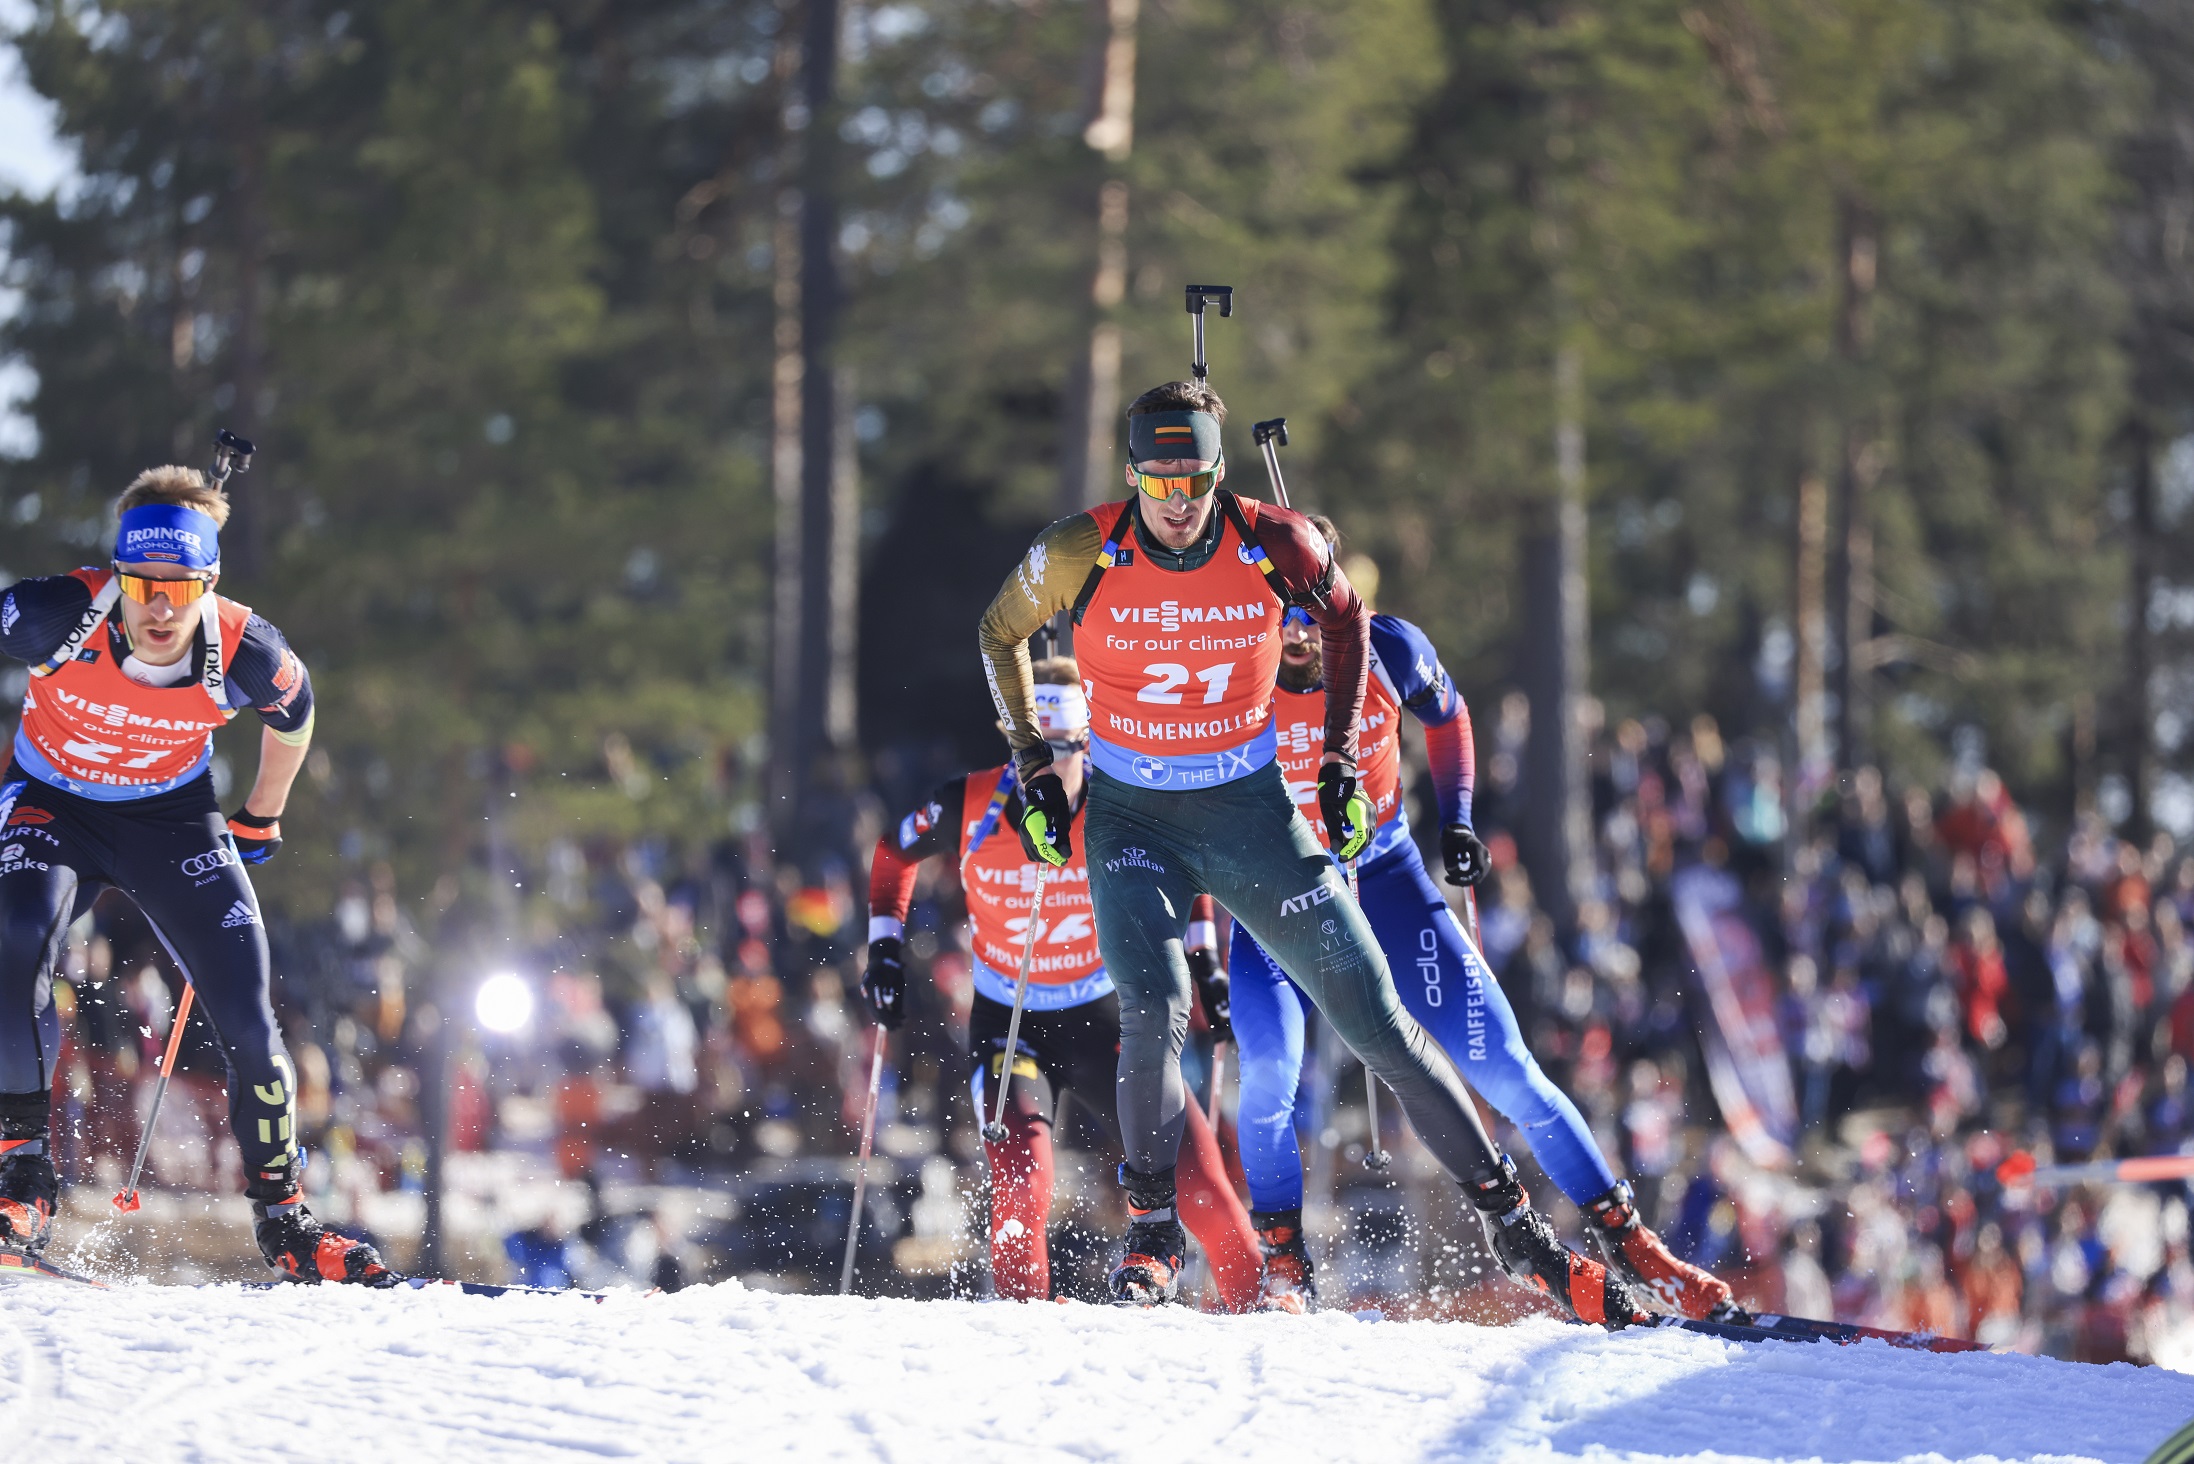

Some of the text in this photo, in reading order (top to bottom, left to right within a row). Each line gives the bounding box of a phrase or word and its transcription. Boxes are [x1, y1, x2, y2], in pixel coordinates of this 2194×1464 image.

[126, 527, 201, 551] ERDINGER
[64, 607, 102, 652] JOKA
[1109, 601, 1265, 632] VIESSMANN
[1106, 632, 1267, 651] for our climate
[1136, 662, 1236, 705] 21
[57, 688, 217, 731] VIESSMANN
[1109, 703, 1266, 740] HOLMENKOLLEN
[1178, 768, 1215, 784] THE
[195, 873, 220, 888] Audi
[1280, 878, 1342, 917] ATEX
[1320, 931, 1352, 952] VIC
[1417, 928, 1442, 1008] odlo
[1462, 953, 1487, 1061] RAIFFEISEN
